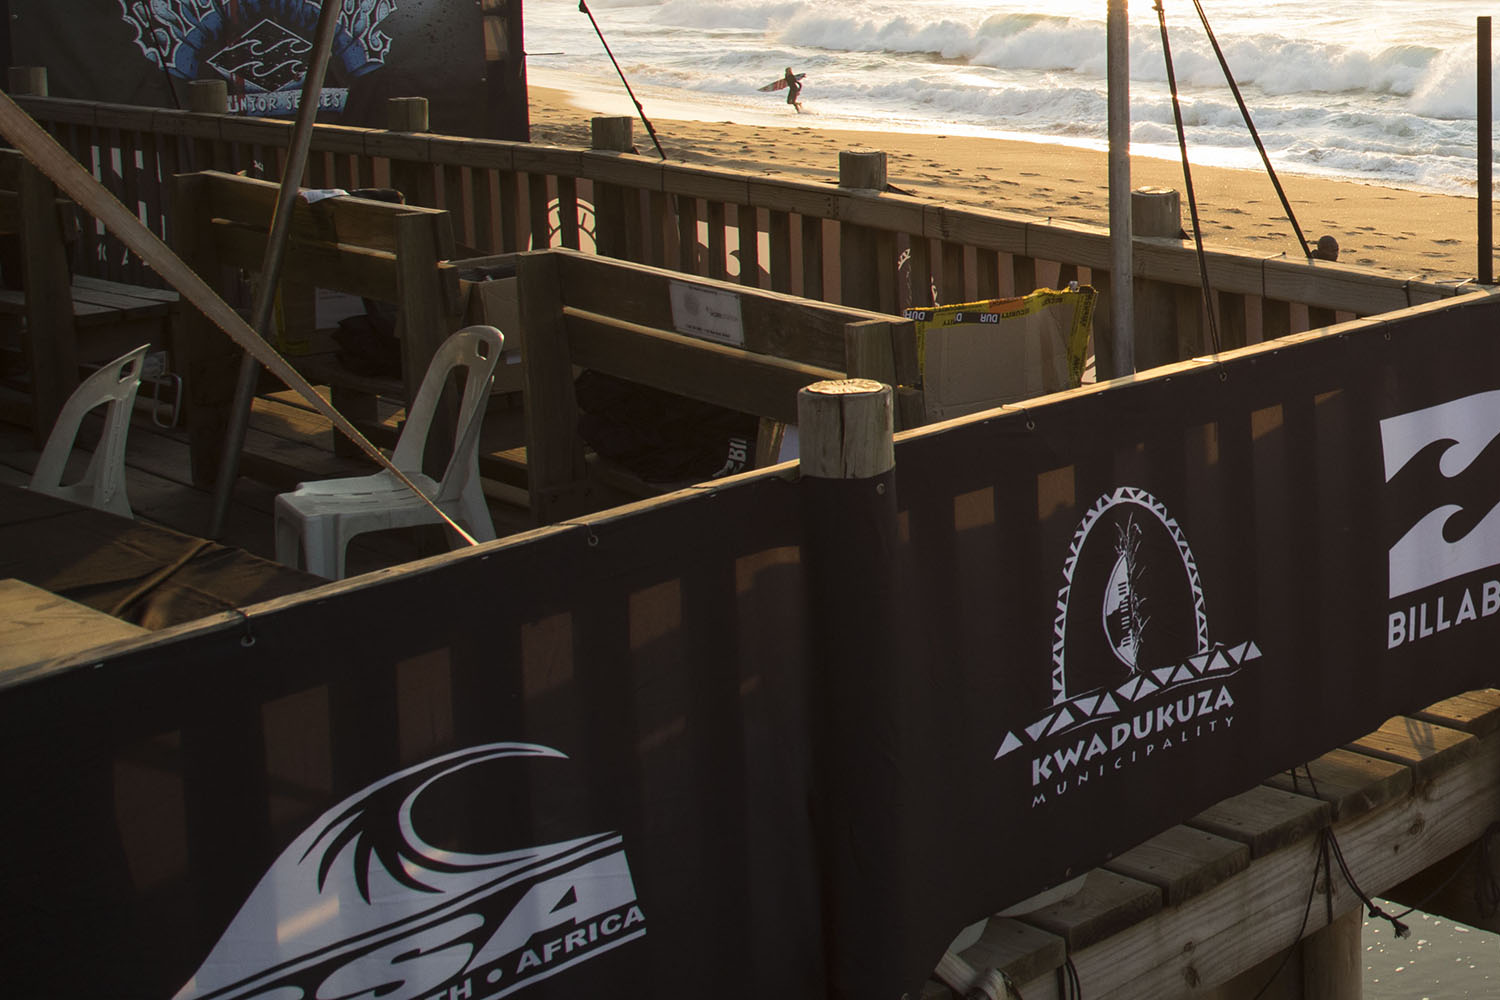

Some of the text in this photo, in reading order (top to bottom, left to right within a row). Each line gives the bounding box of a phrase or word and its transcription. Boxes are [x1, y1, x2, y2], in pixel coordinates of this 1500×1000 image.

[226, 91, 341, 113] UNIOR SEES
[1032, 685, 1235, 786] KWADUKUZA
[1032, 716, 1235, 808] MUNICIPALITY
[515, 905, 646, 974] AFRICA
